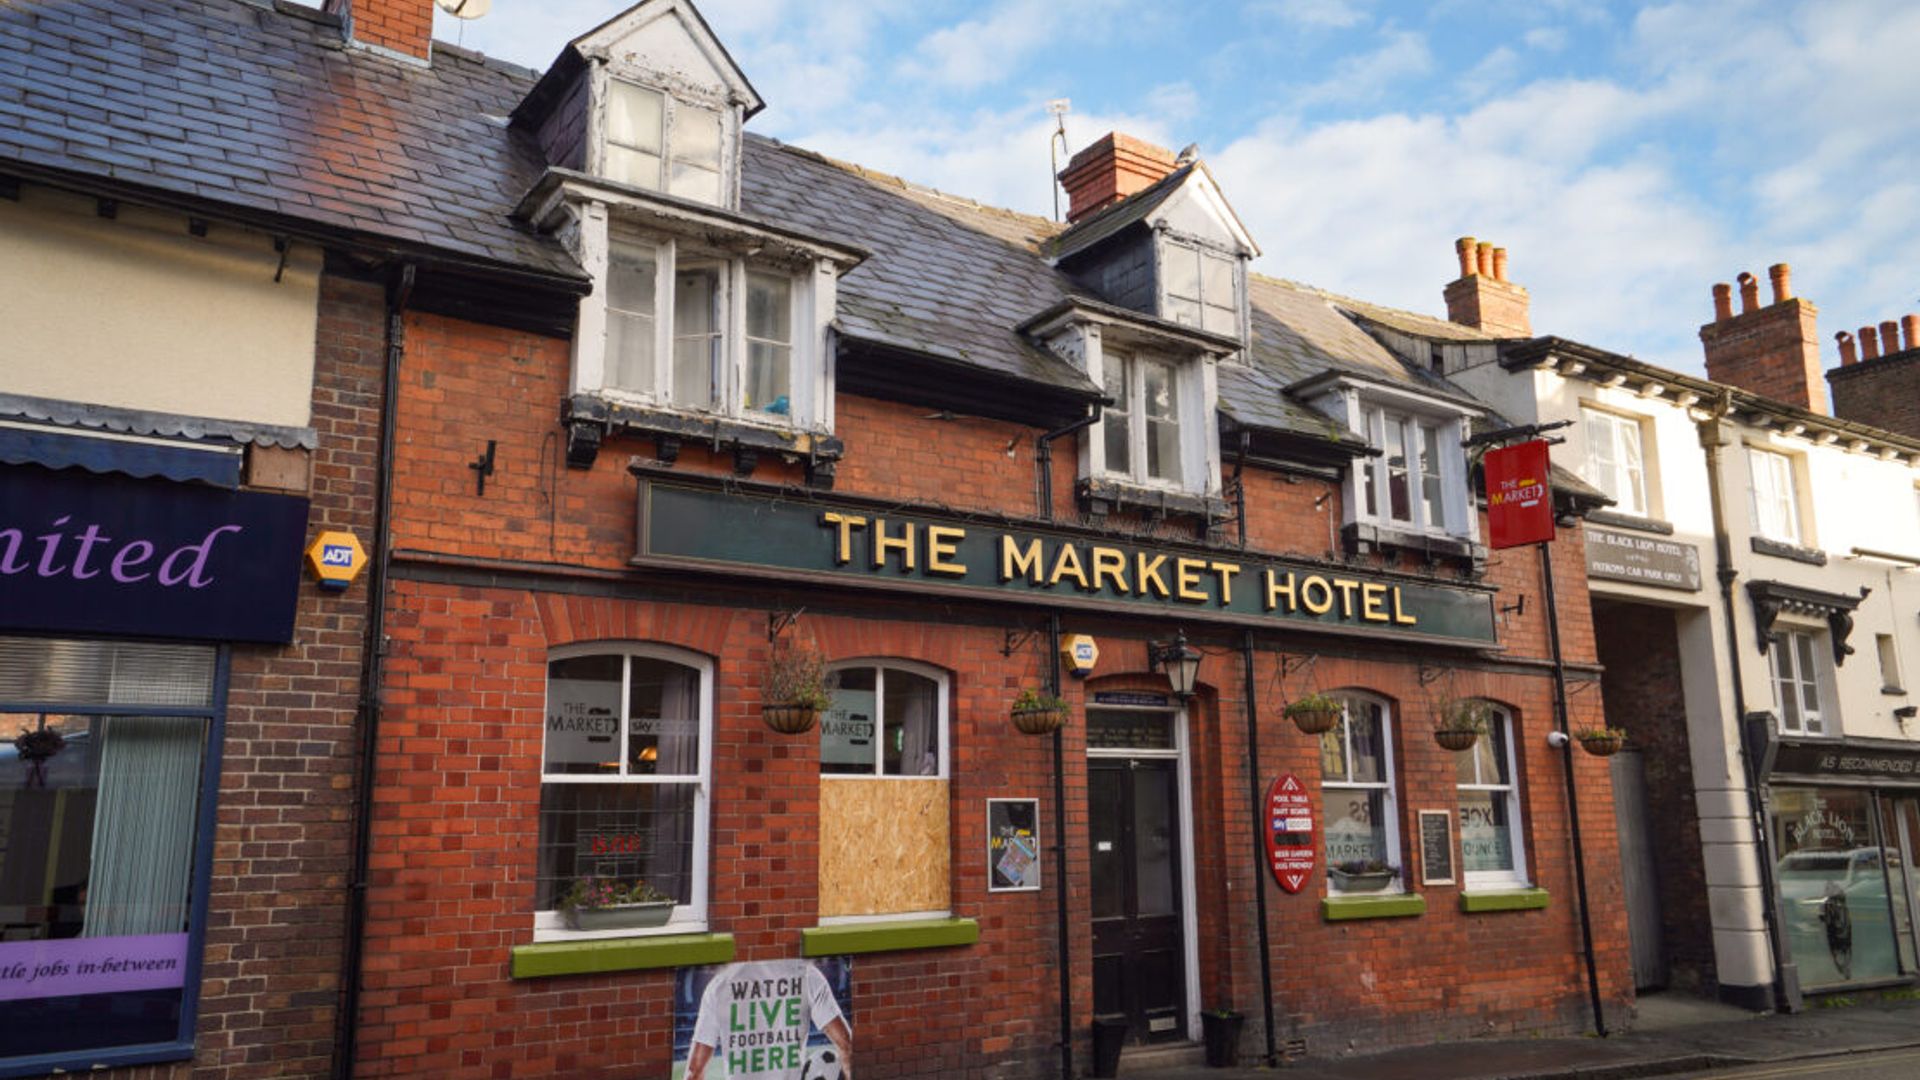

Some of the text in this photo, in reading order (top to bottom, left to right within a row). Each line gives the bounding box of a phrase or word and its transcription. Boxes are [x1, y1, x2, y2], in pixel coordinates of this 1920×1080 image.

[1491, 485, 1537, 505] MARKET
[1501, 480, 1517, 490] THE
[1588, 531, 1604, 544] THE
[1607, 534, 1634, 549] BLACK
[1636, 538, 1655, 552] LION
[323, 547, 353, 564] ADT
[823, 512, 1416, 625] THE MARKET HOTEL
[563, 702, 586, 715] THE
[547, 716, 614, 732] MARKET
[1821, 756, 1837, 769] AS
[1839, 757, 1913, 773] RECOMMENDED
[27, 958, 70, 983] jobs
[76, 957, 177, 976] in-between
[731, 977, 802, 1000] WATCH
[730, 997, 802, 1032] LIVE
[729, 1029, 801, 1048] FOOTBALL
[729, 1043, 801, 1075] HERE
